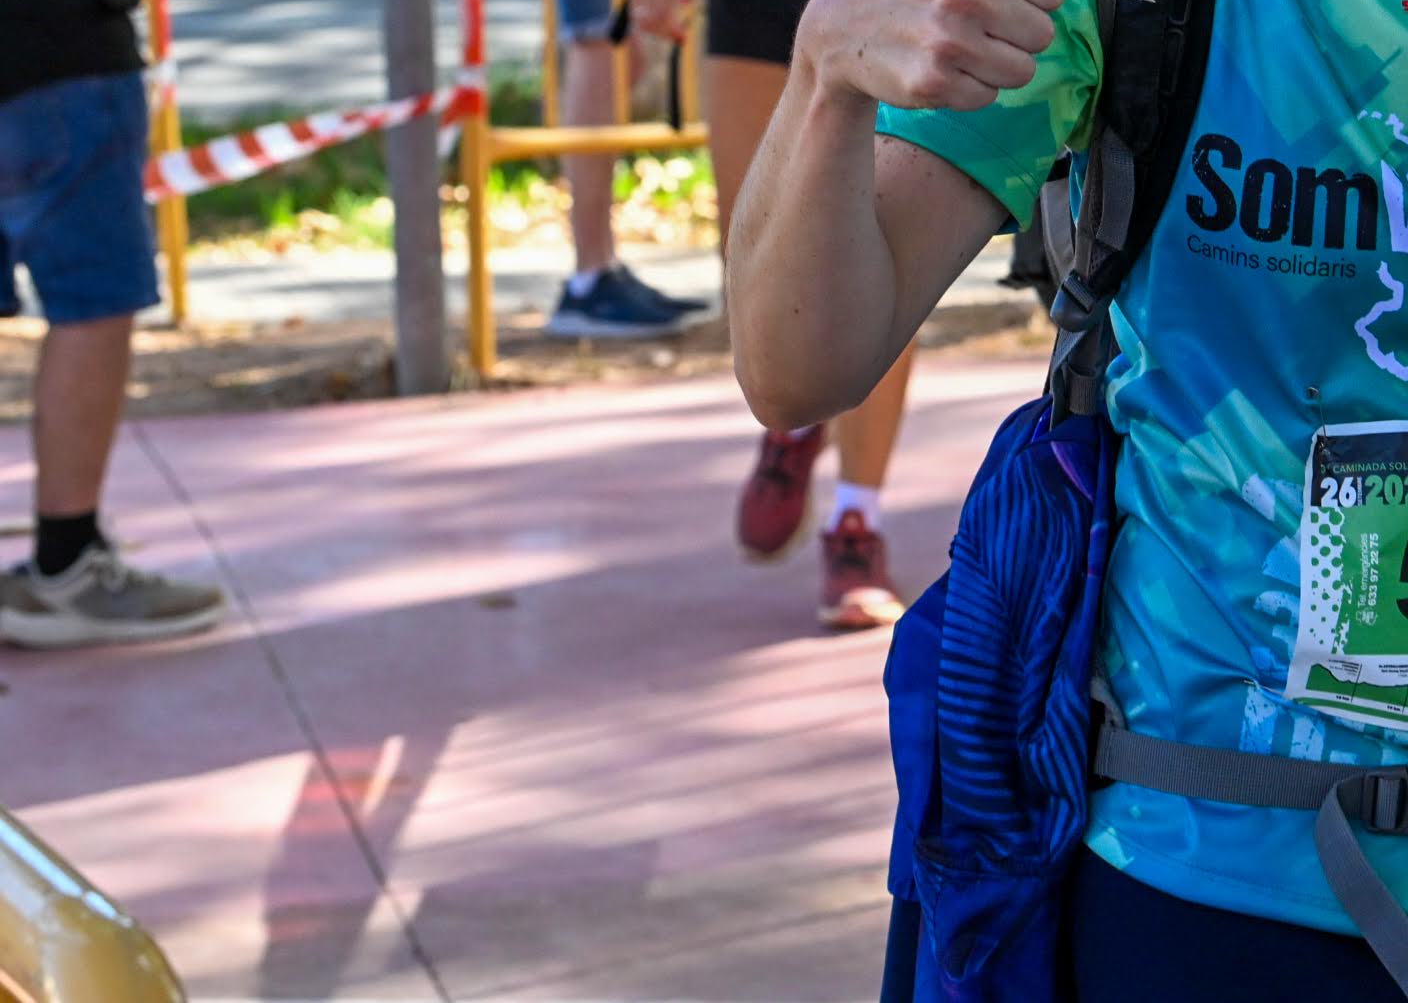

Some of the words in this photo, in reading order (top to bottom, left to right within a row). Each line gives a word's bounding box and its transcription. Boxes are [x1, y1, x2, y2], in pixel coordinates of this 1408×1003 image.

[1187, 234, 1260, 270] Camins
[1266, 254, 1356, 278] solidaris
[1320, 476, 1357, 508] 26
